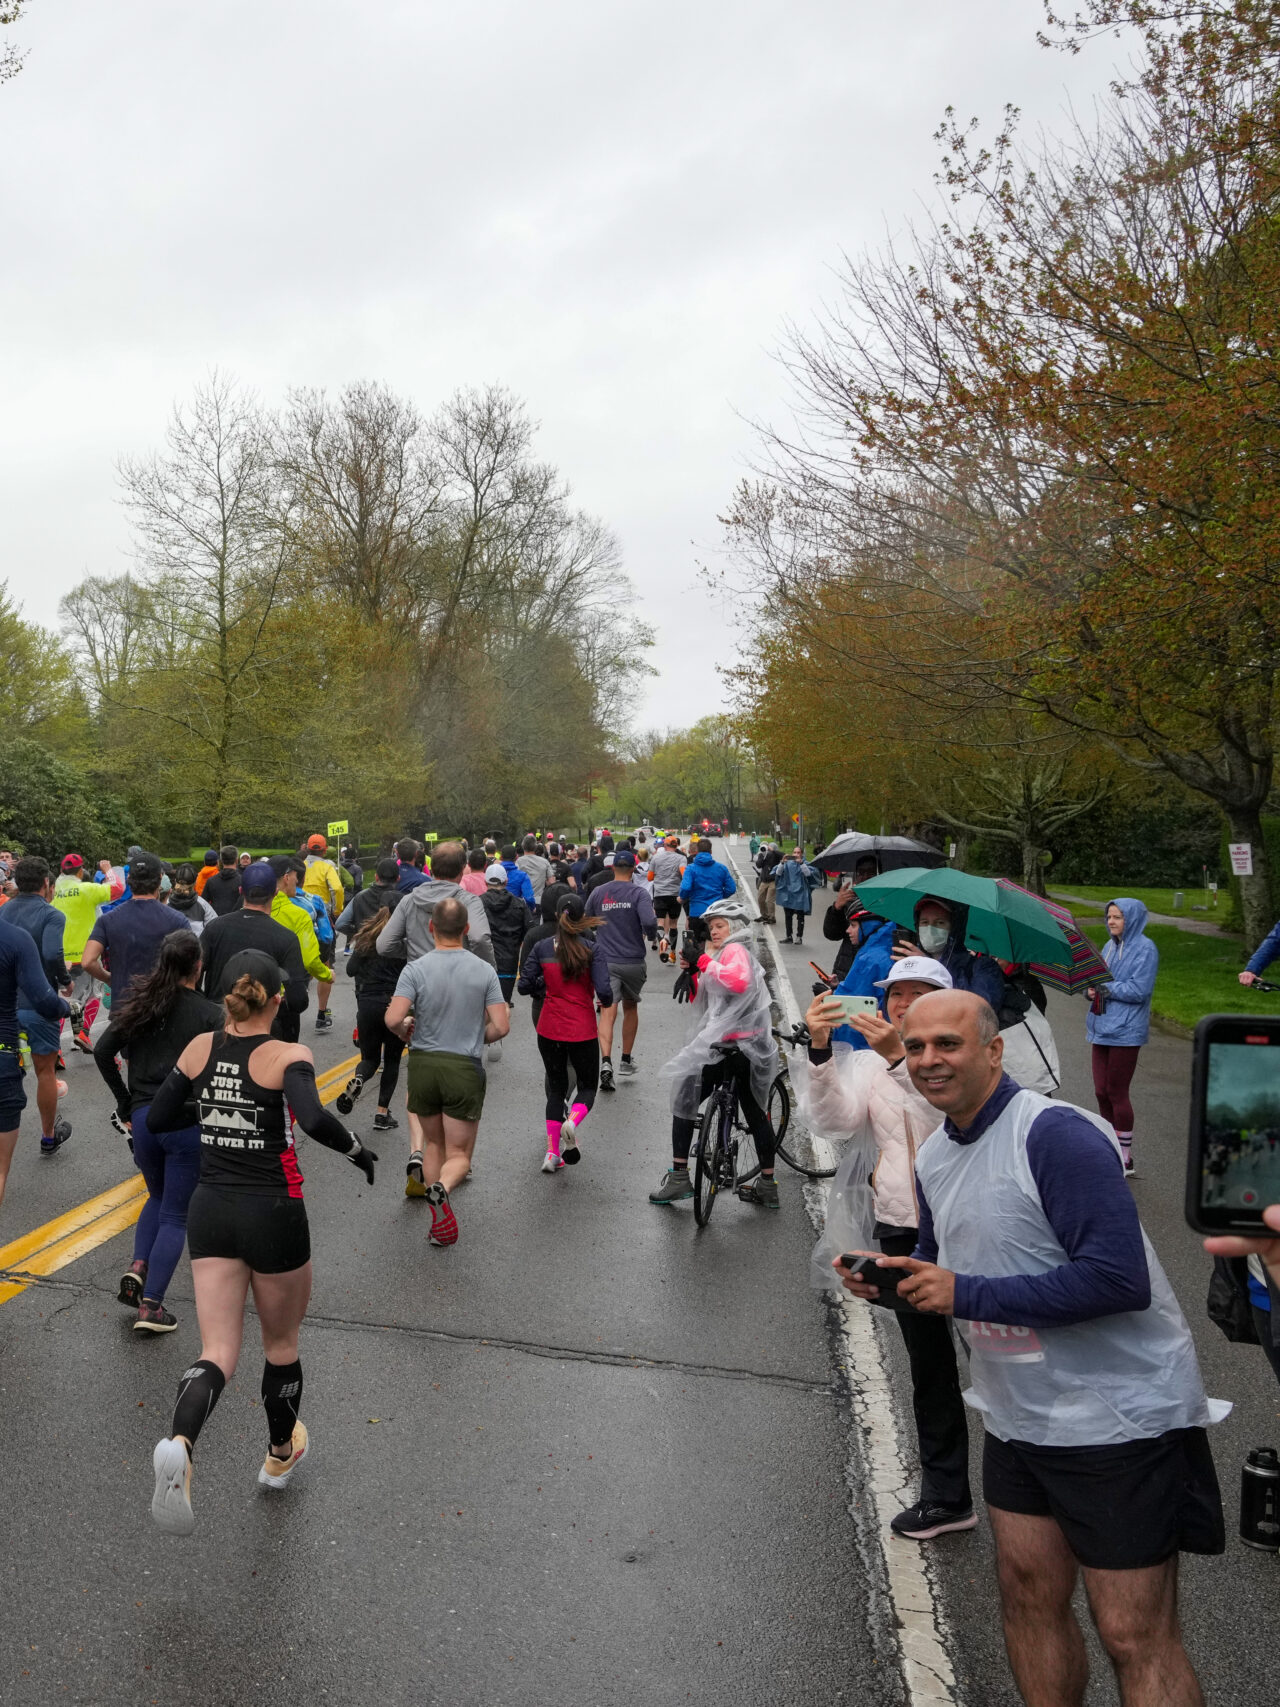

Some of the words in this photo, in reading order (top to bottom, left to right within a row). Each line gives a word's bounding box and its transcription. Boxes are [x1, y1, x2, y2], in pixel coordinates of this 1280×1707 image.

[216, 1061, 240, 1075] IT'S
[210, 1075, 243, 1090] JUST
[201, 1087, 210, 1099] A
[214, 1089, 255, 1105] HILL...
[200, 1133, 215, 1145] GET
[217, 1136, 245, 1148] OVER
[248, 1139, 265, 1149] IT!
